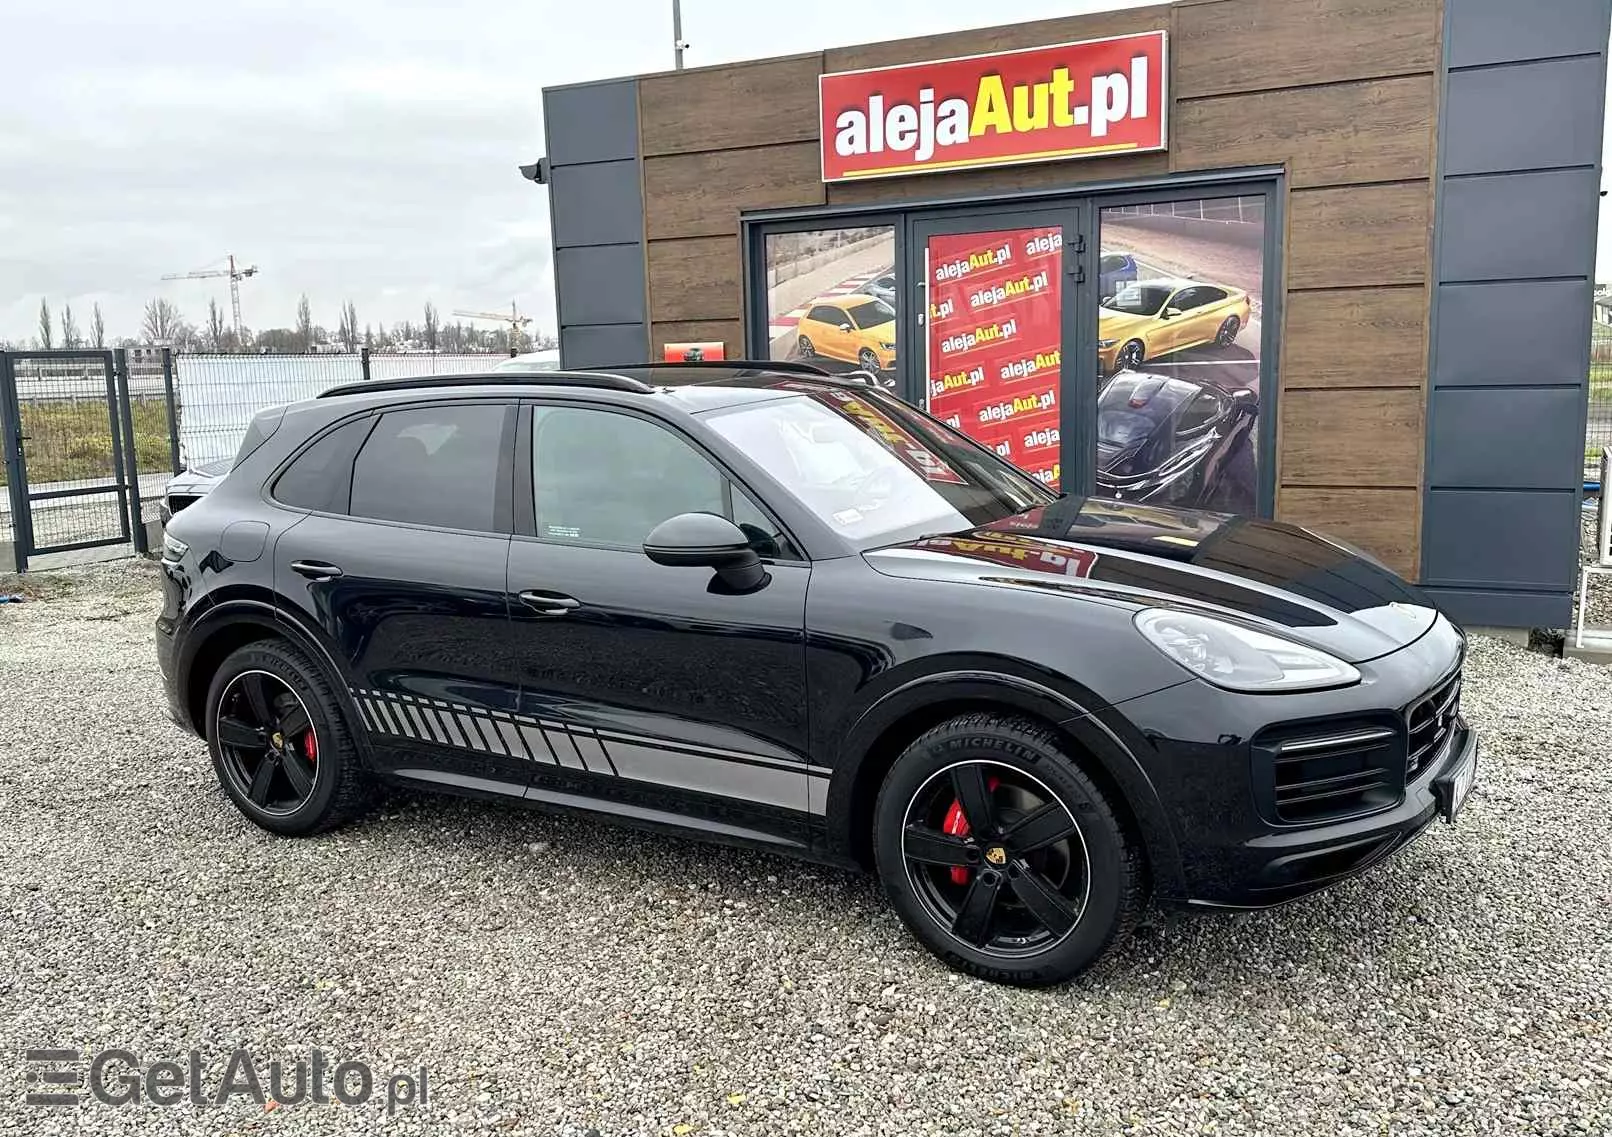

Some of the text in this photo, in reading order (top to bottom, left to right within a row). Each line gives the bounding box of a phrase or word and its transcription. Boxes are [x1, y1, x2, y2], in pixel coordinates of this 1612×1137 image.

[834, 55, 1149, 161] alejaAut.pl
[935, 244, 1012, 281] alejaAut.pl
[970, 271, 1049, 307] alejaAut.pl
[929, 299, 954, 320] t.pl
[941, 319, 1017, 353] alejaAut.pl
[979, 390, 1056, 422] alejaAut.pl
[949, 736, 1037, 761] MICHELIN
